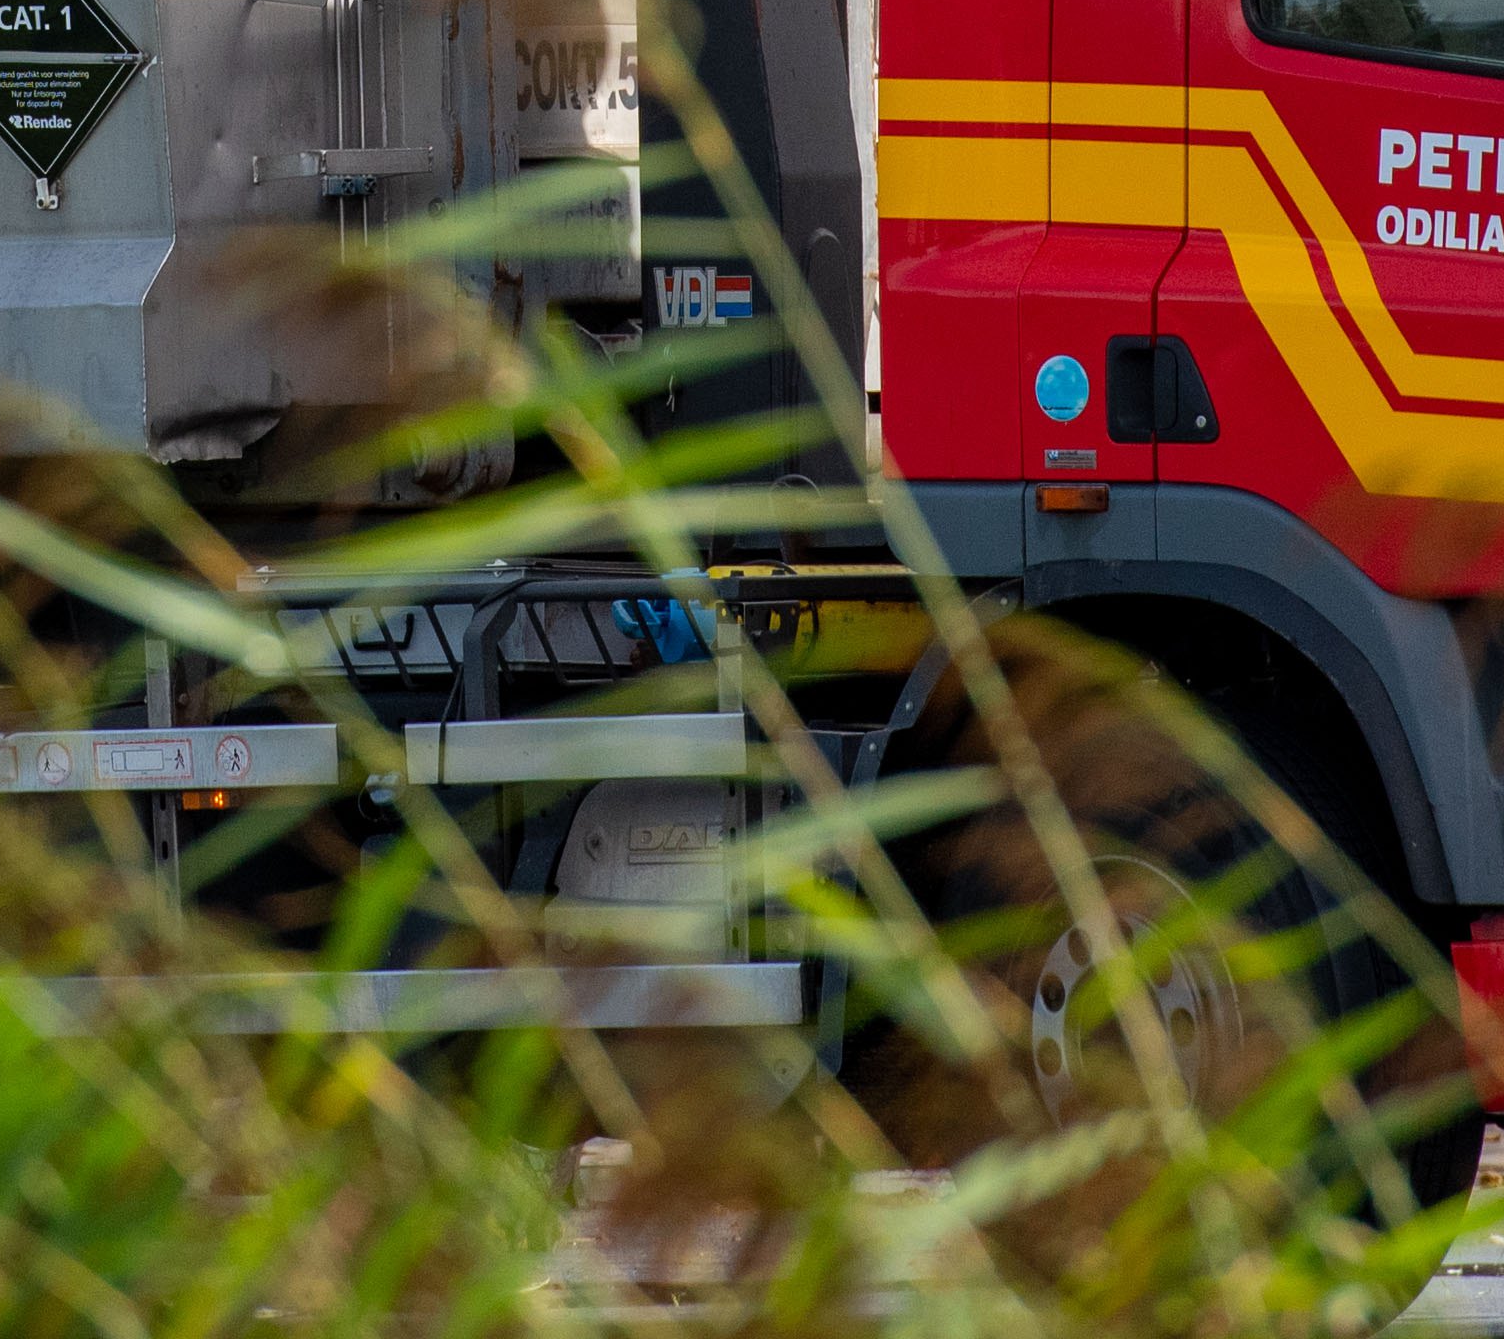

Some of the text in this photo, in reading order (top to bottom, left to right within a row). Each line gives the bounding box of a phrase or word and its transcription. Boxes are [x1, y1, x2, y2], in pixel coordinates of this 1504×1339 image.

[59, 5, 72, 31] 1
[24, 114, 72, 129] Rendac
[653, 266, 728, 327] VDL
